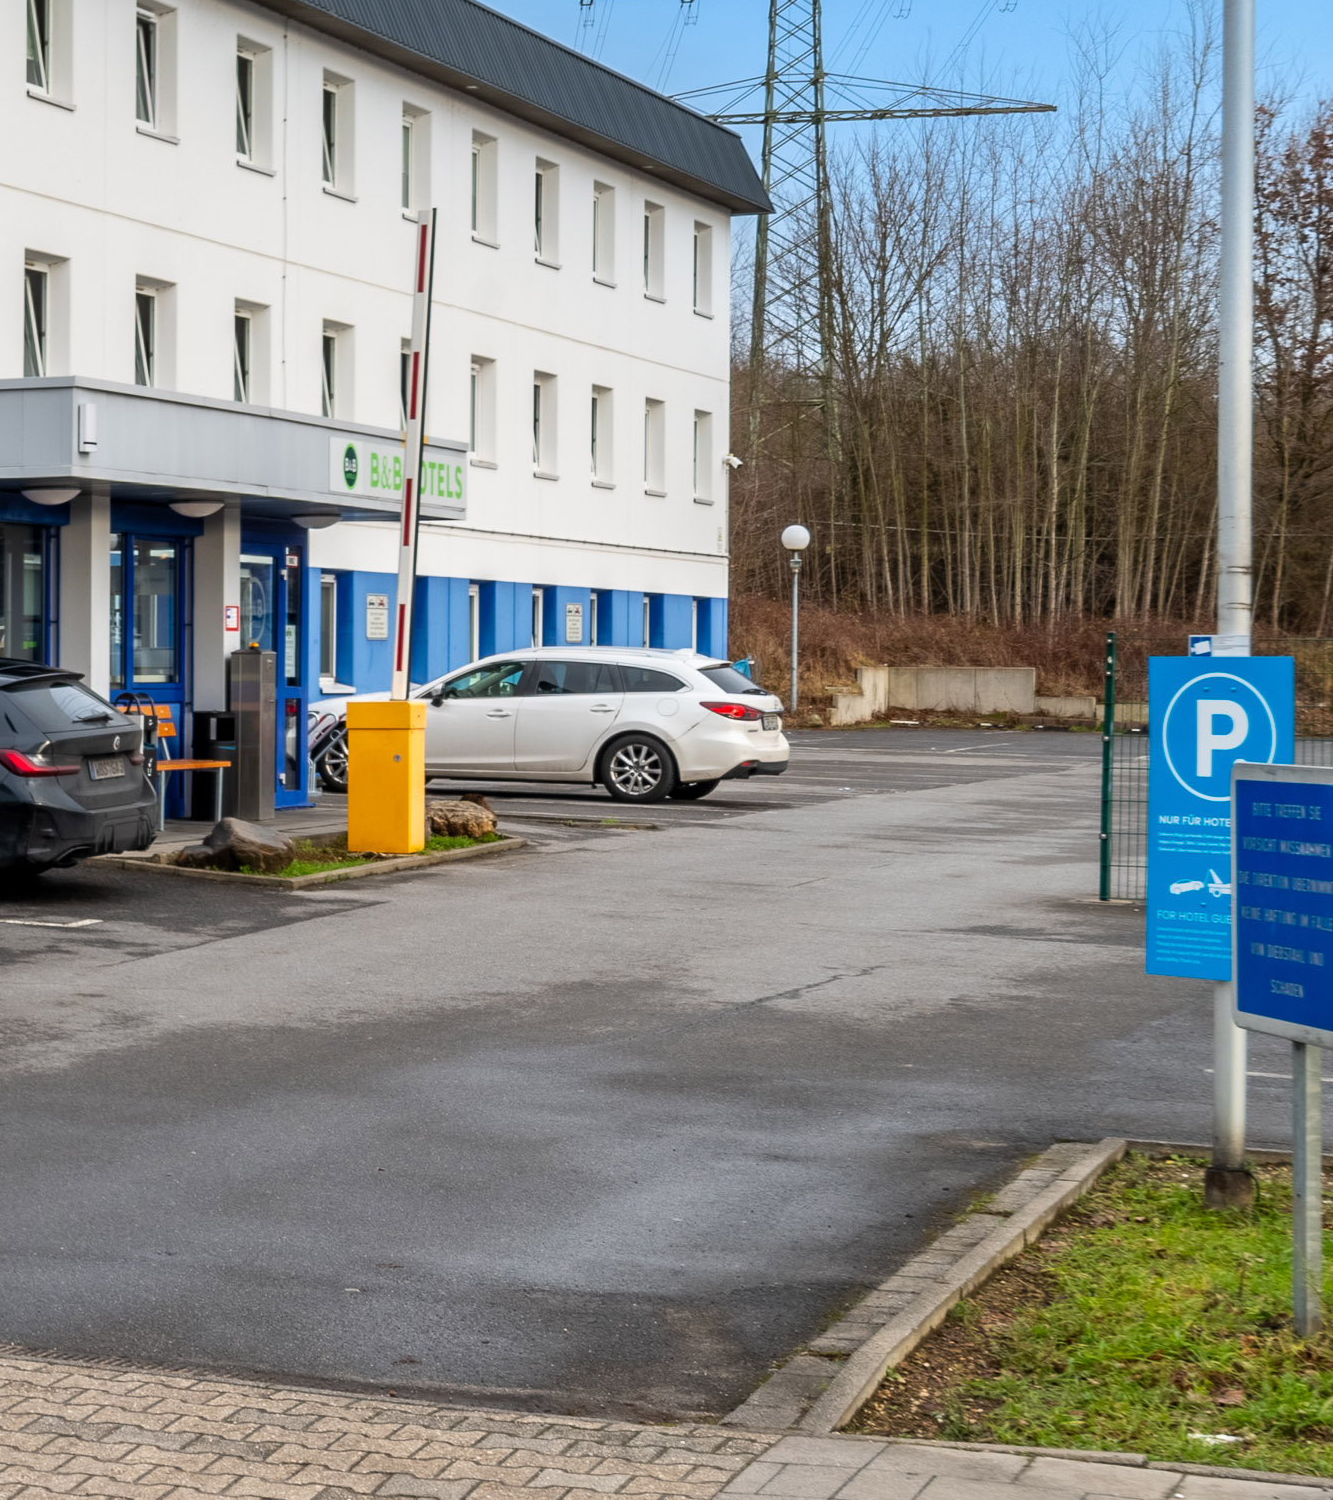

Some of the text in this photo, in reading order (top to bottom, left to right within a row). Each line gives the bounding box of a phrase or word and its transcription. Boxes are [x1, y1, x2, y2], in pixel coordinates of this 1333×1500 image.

[370, 451, 464, 499] B&B OTELS
[1196, 699, 1249, 778] P
[1158, 814, 1231, 827] NUR FÜR HOTE
[1156, 909, 1177, 921] FOR
[1179, 911, 1210, 923] HOTEL
